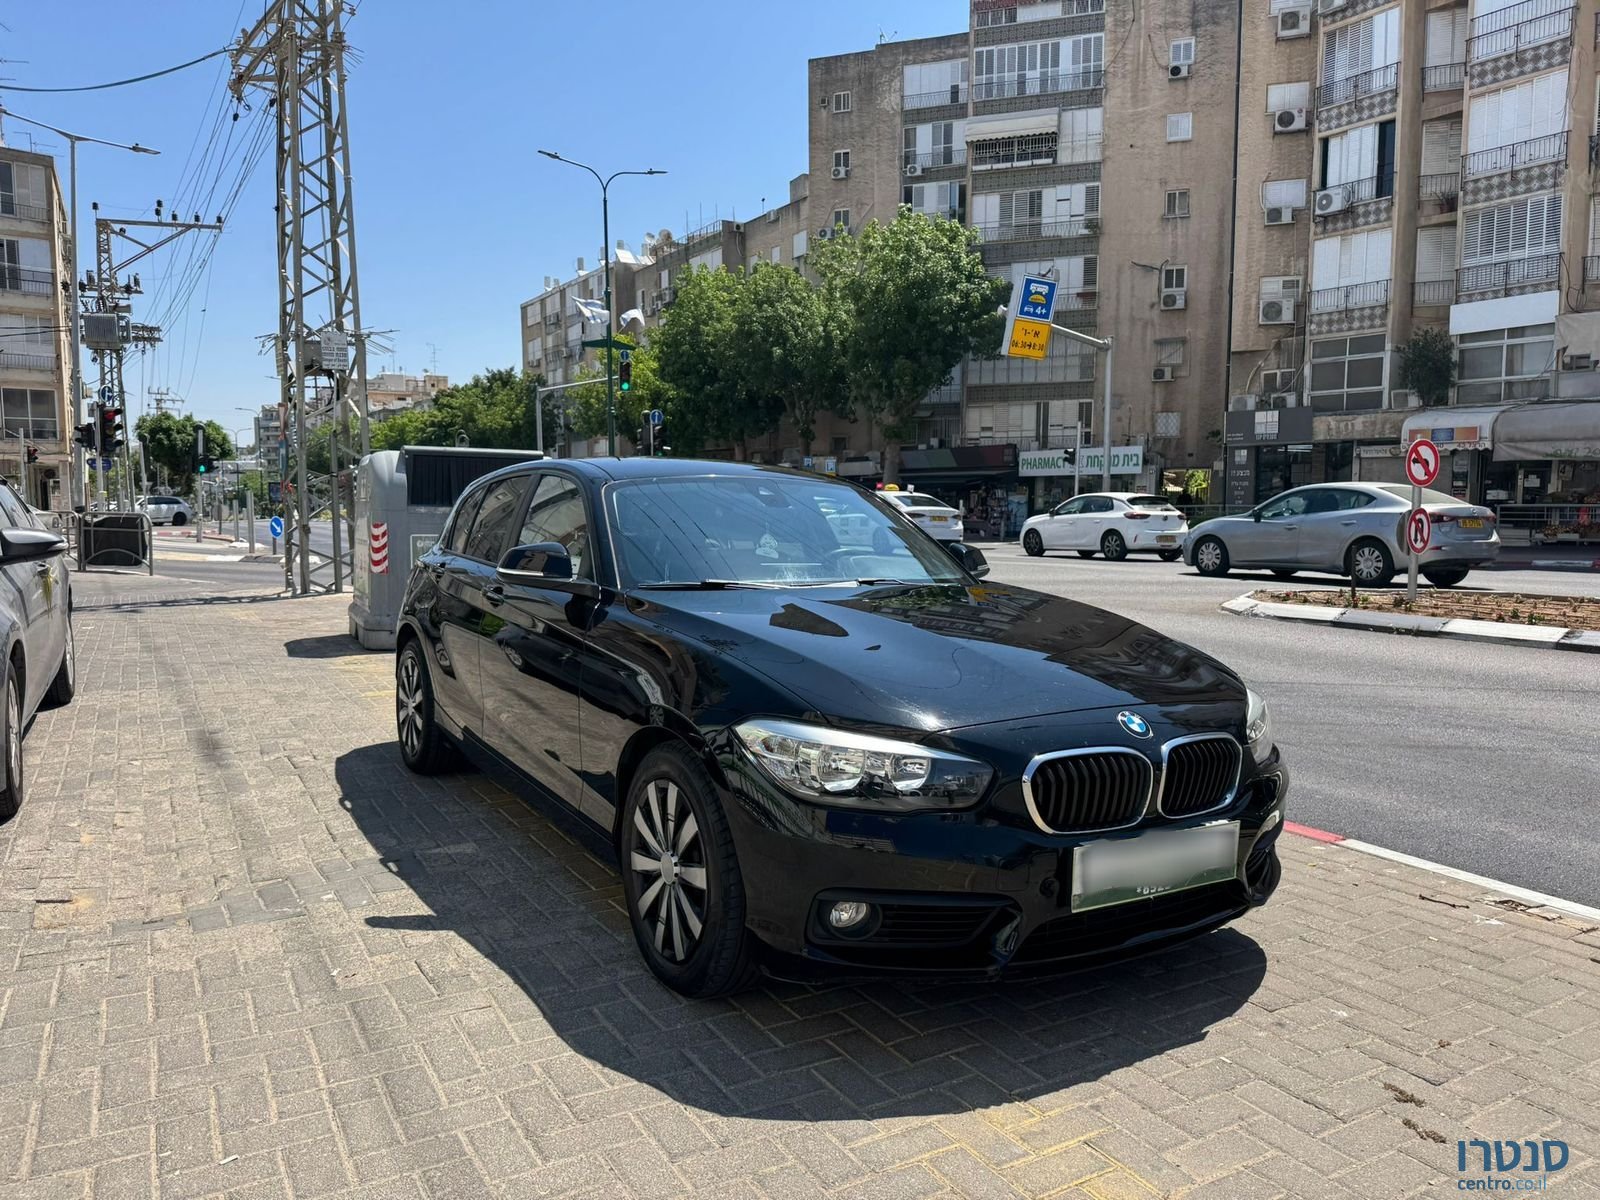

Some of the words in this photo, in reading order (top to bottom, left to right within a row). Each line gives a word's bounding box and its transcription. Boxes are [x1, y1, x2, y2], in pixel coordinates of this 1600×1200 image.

[1035, 306, 1047, 315] 4+
[1085, 454, 1120, 472] מקחת
[1121, 453, 1140, 467] בית
